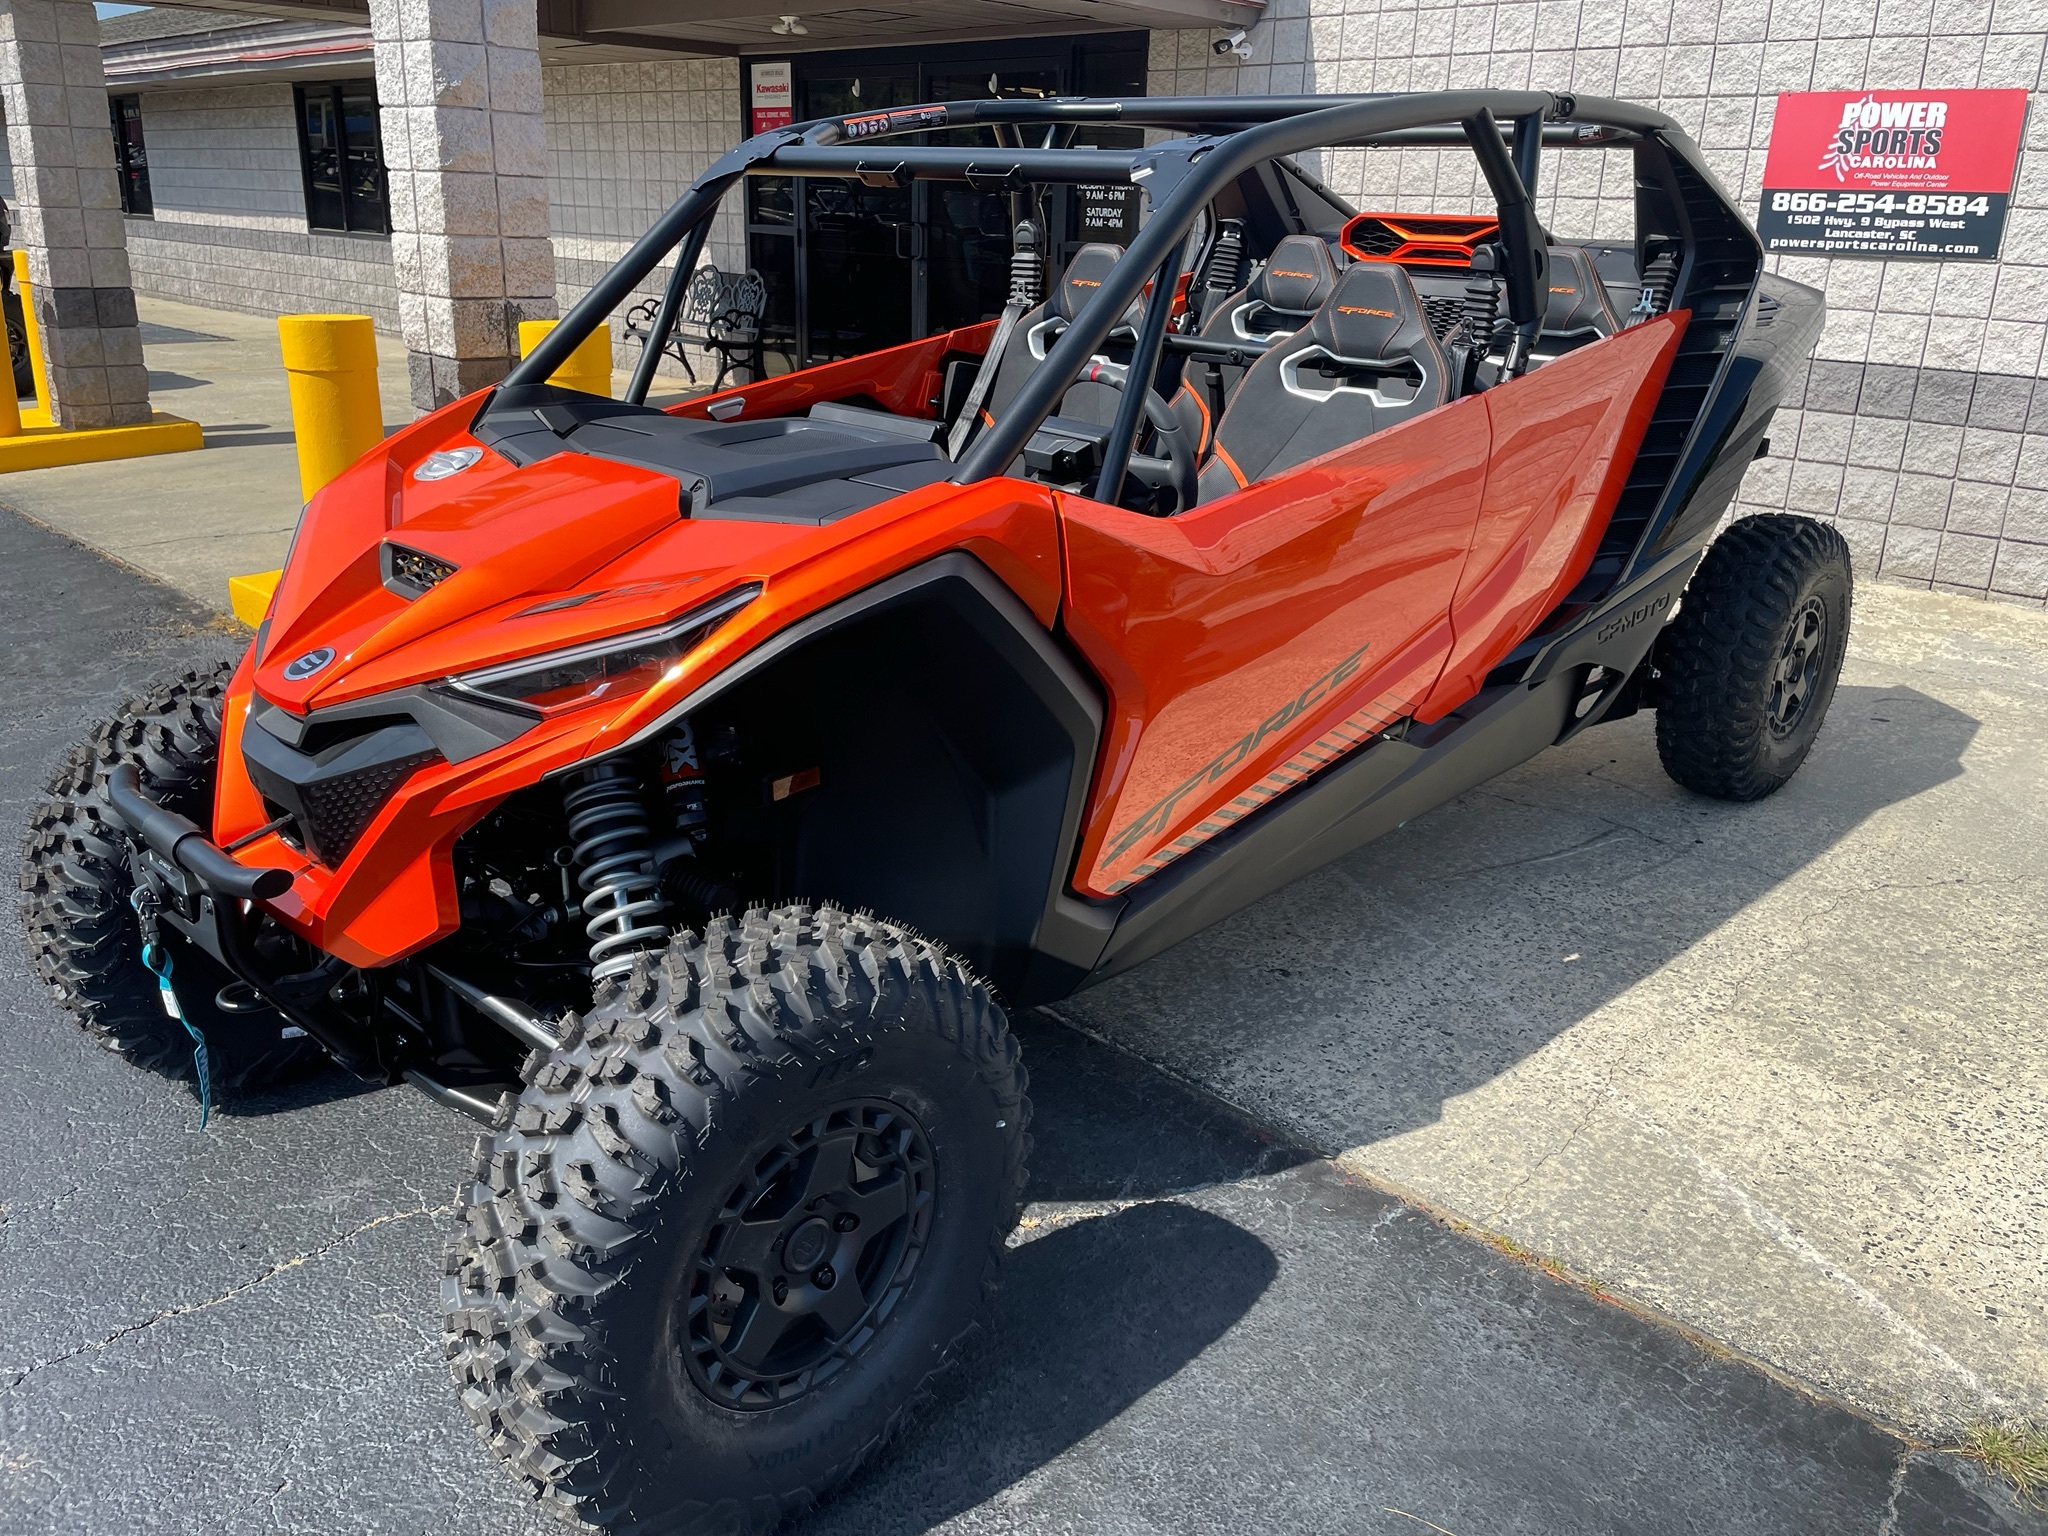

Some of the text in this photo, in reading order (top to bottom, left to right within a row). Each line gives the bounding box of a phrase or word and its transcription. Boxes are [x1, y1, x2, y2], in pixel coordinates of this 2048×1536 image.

[756, 83, 789, 94] Kawasaki
[1840, 102, 1948, 129] POWER
[1836, 129, 1942, 155] SPORTS
[1849, 156, 1937, 169] CAROLINA
[1853, 172, 1950, 181] Off-Road Vehicles And Outdoor
[1870, 179, 1891, 187] Power
[1891, 180, 1925, 188] Equipment
[1085, 190, 1091, 200] 9
[1091, 190, 1104, 200] AM
[1771, 192, 1990, 217] 866-254-8584
[1086, 207, 1122, 218] SATURDAY
[1085, 217, 1090, 227] 9
[1090, 217, 1103, 227] AM
[1787, 214, 1966, 230] 1502 Hwy. 9 Bypass West
[1824, 227, 1917, 241] Lancaster, SC
[1769, 238, 1979, 254] powersportscarolina.com
[1271, 270, 1314, 279] ZFORCE
[1337, 306, 1396, 319] ZFORCE
[1597, 592, 1671, 646] CFMOTO
[1100, 641, 1370, 871] ZFORCE
[666, 779, 705, 794] PERFORMANCE
